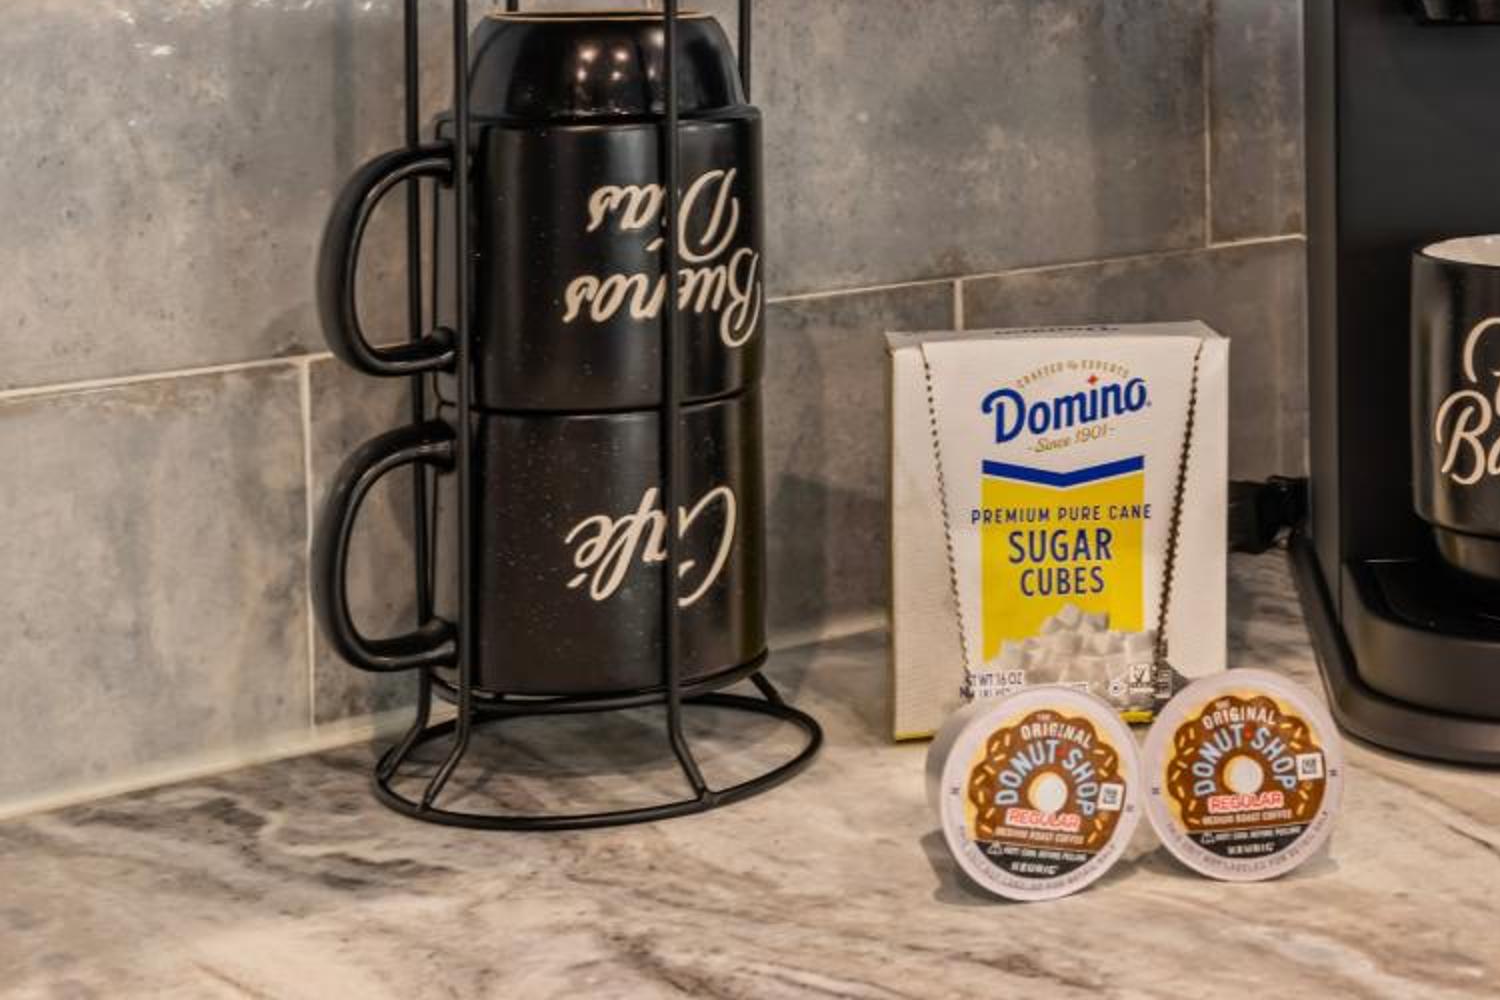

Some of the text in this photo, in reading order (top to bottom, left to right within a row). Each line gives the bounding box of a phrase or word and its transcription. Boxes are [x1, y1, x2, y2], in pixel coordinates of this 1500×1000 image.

[562, 247, 761, 348] Buenos
[981, 375, 1147, 444] Domino
[971, 504, 1152, 525] PREMIUM PURE CANE
[1008, 527, 1113, 564] SUGAR
[1020, 566, 1105, 597] CUBES
[1202, 706, 1276, 730] ORIGINAL
[1020, 722, 1093, 748] ORIGINAL
[1192, 723, 1297, 797] DONUT SHOP
[995, 739, 1098, 818] DONUT SHOP
[1208, 791, 1284, 814] REGULAR
[1005, 807, 1081, 832] REGULAR
[1010, 861, 1059, 876] KEURIG
